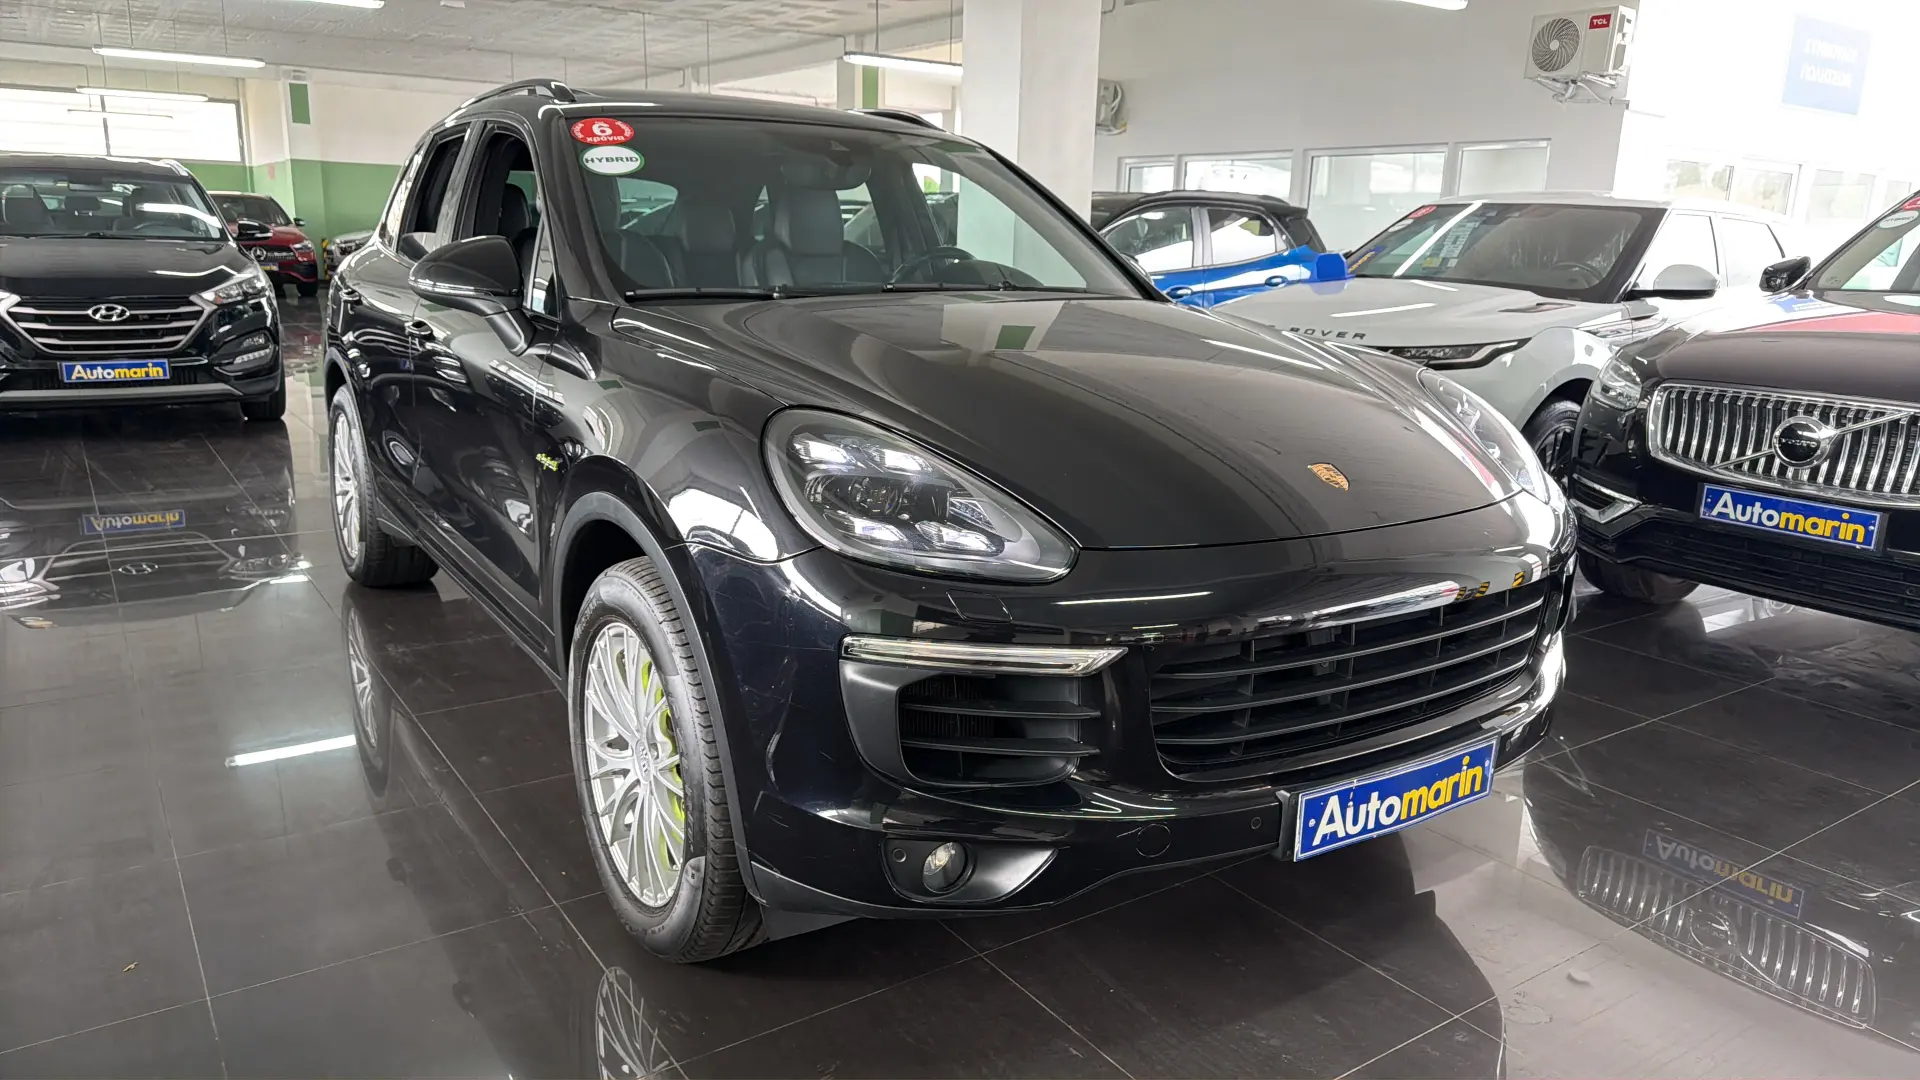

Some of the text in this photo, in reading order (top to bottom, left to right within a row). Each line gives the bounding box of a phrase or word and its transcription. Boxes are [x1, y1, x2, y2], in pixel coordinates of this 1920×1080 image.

[592, 123, 613, 136] 6
[1289, 326, 1367, 340] ROVER
[71, 362, 163, 380] Automarin
[1711, 491, 1865, 543] Automarin
[1312, 755, 1484, 847] Automarin
